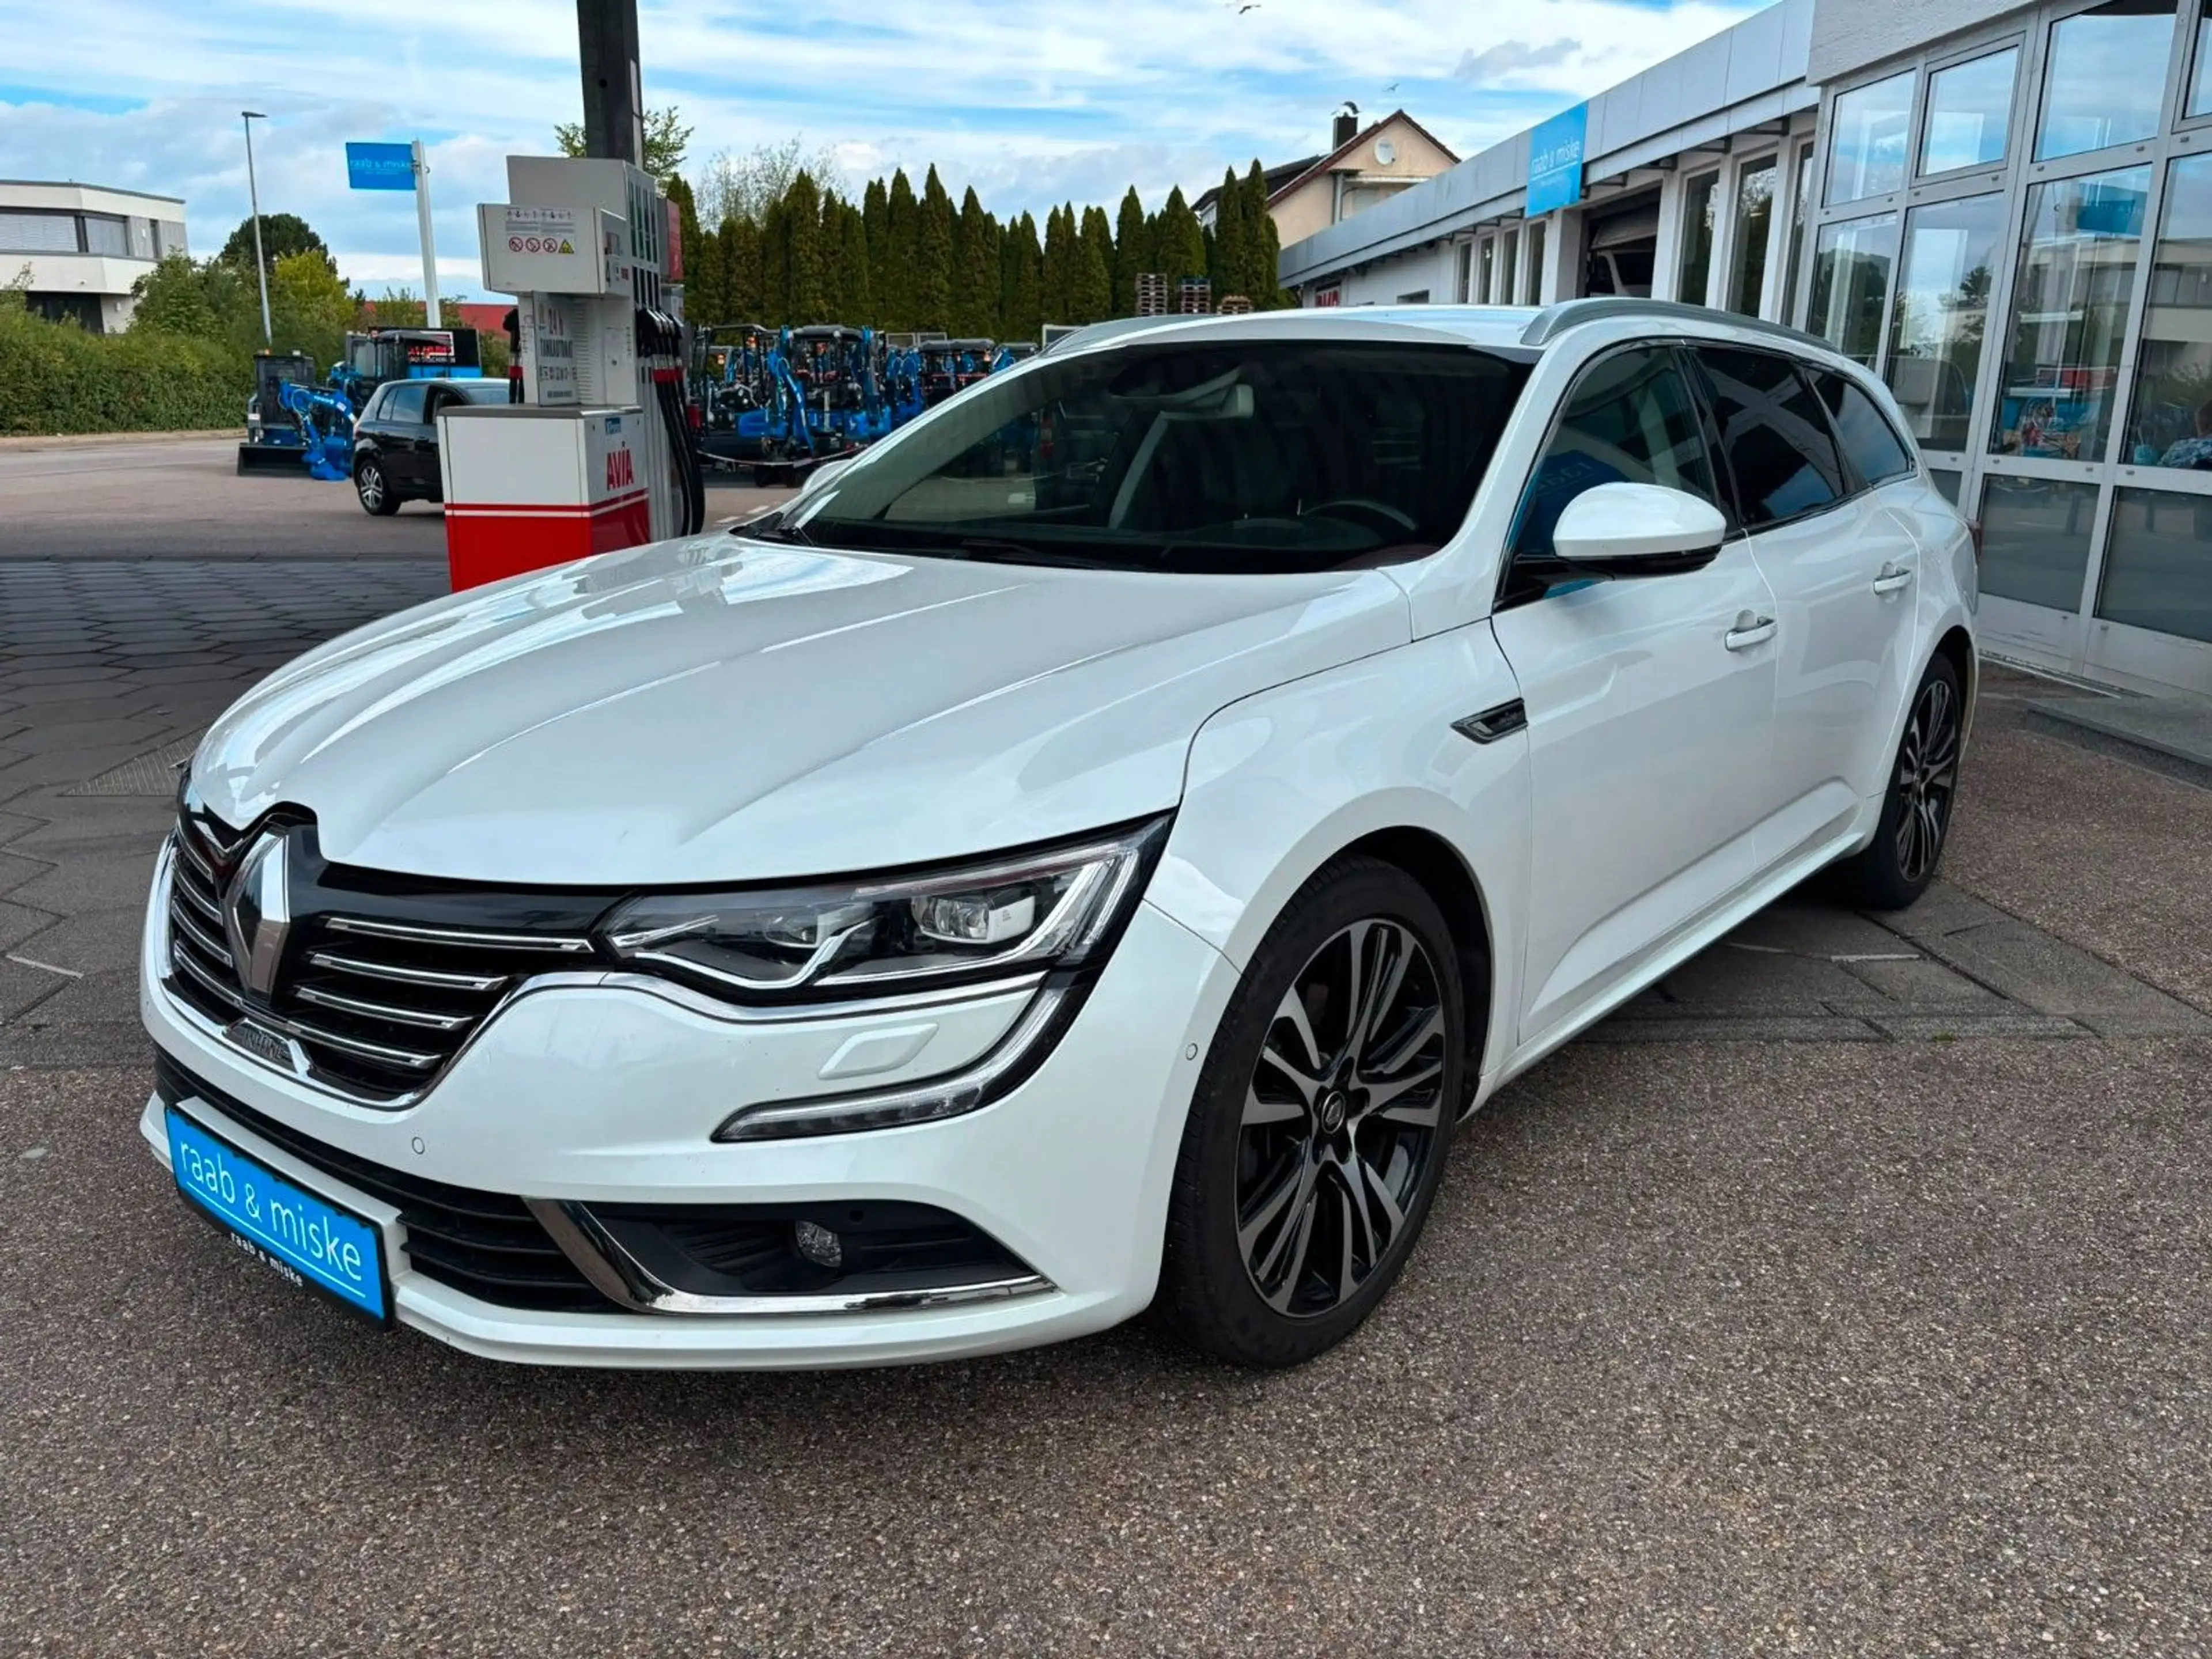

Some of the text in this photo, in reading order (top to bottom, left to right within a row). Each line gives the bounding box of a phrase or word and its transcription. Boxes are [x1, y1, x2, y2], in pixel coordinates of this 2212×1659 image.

[607, 449, 634, 491] AVIA
[180, 1141, 362, 1282] raab & miske
[230, 1232, 304, 1287] raab & miske
